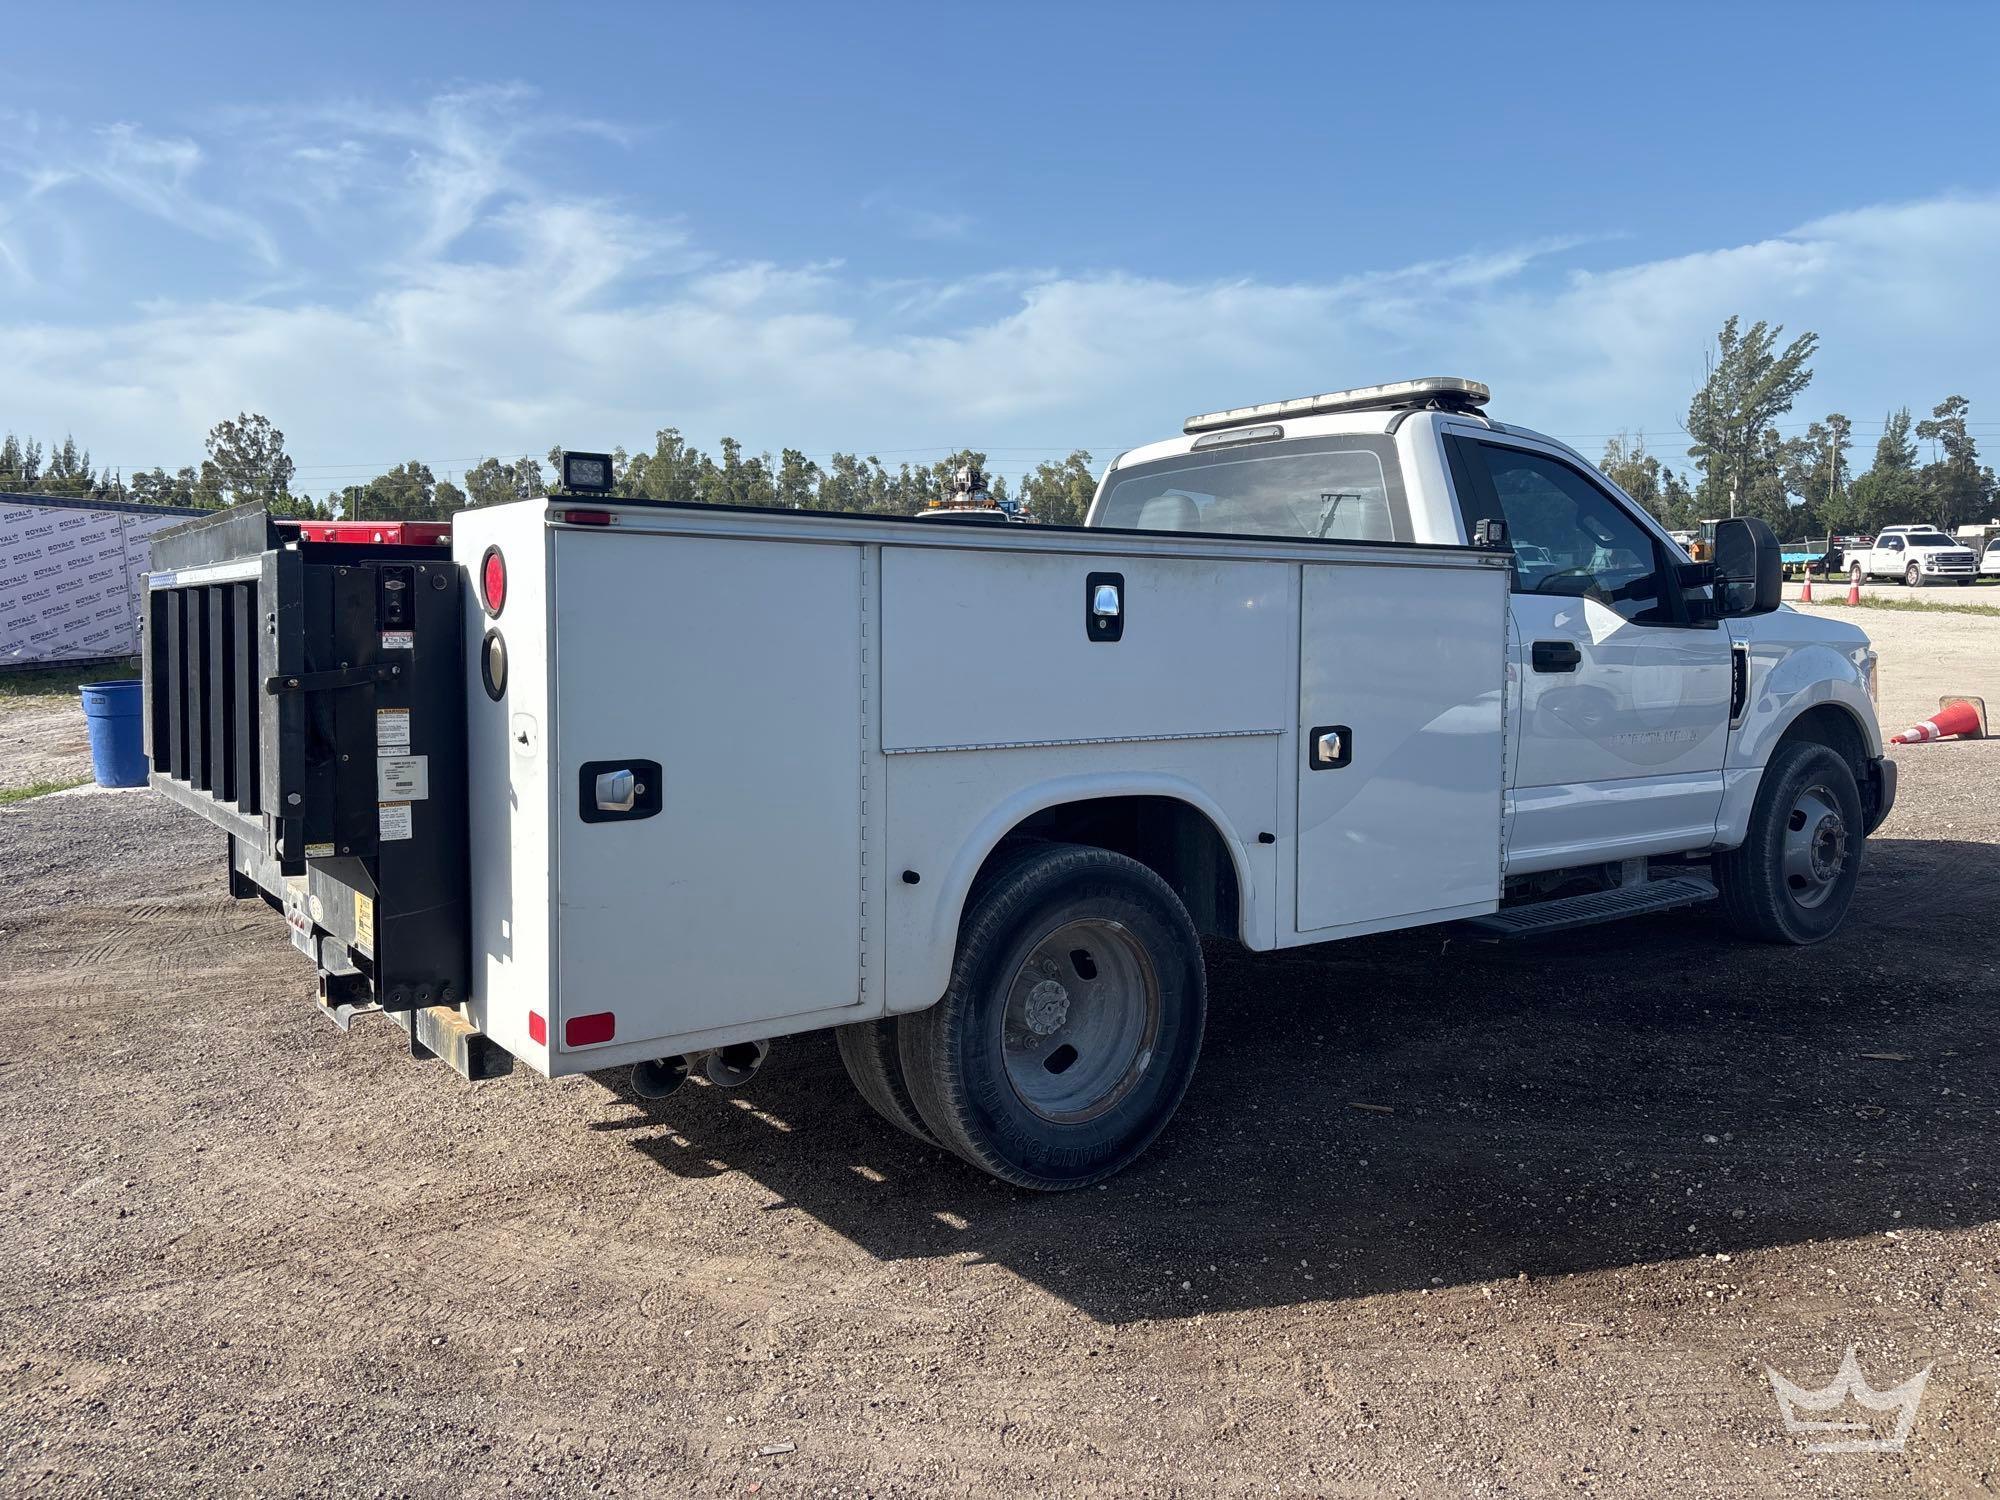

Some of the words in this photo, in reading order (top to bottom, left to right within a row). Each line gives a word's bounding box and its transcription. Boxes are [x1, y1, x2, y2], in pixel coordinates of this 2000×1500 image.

[4, 511, 27, 520] ROYAL
[59, 518, 80, 528] ROYAL
[25, 527, 47, 536] ROYAL
[81, 533, 100, 542] ROYAL
[48, 541, 69, 551] ROYAL
[13, 551, 36, 561] ROYAL
[99, 547, 118, 557] ROYAL
[67, 557, 88, 566] ROYAL
[34, 566, 56, 576] ROYAL
[89, 571, 108, 580] ROYAL
[56, 580, 77, 591] ROYAL
[106, 584, 128, 594] ROYAL
[22, 591, 44, 601] ROYAL
[76, 594, 95, 604] ROYAL
[43, 605, 64, 616] ROYAL
[96, 608, 116, 617] ROYAL
[8, 616, 30, 627] ROYAL
[64, 618, 84, 629] ROYAL
[114, 621, 131, 630] ROYA
[31, 629, 53, 641] ROYAL
[83, 631, 103, 642] ROYAL
[0, 641, 17, 652] OYAL
[52, 643, 72, 654] ROYAL
